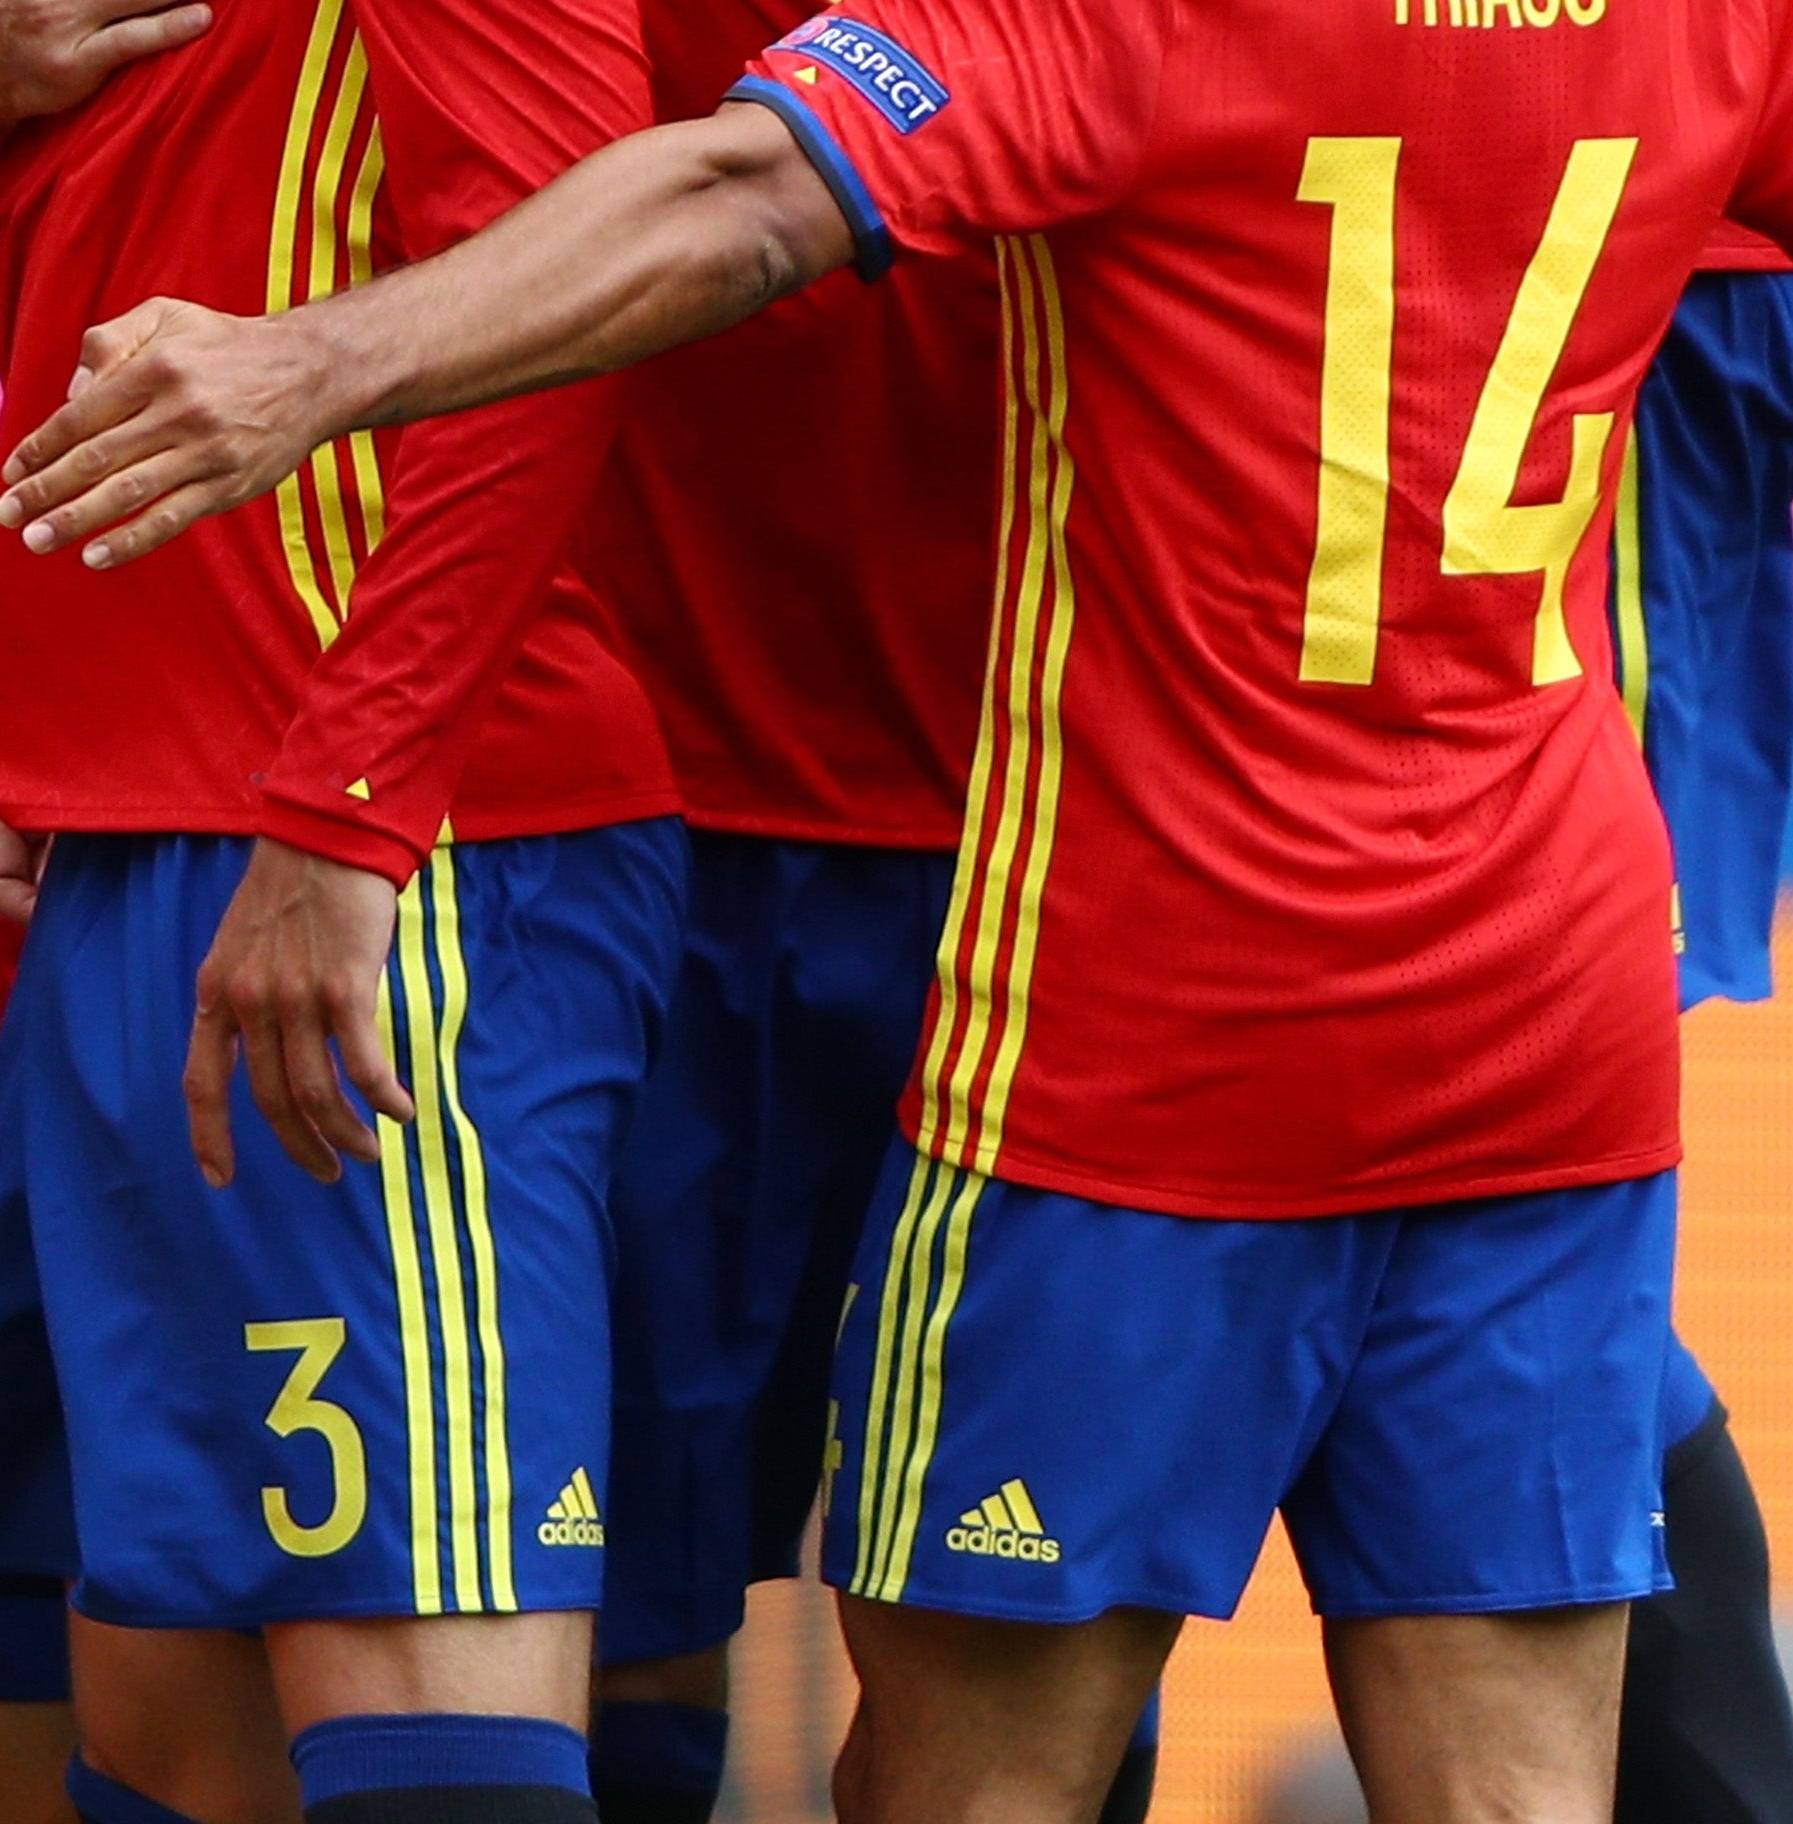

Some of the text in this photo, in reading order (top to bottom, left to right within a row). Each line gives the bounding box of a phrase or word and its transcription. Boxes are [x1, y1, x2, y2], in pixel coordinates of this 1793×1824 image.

[812, 27, 937, 120] RESPECT
[1295, 135, 1639, 686] 14
[243, 1316, 368, 1558] 3
[945, 1526, 1060, 1562] adidas
